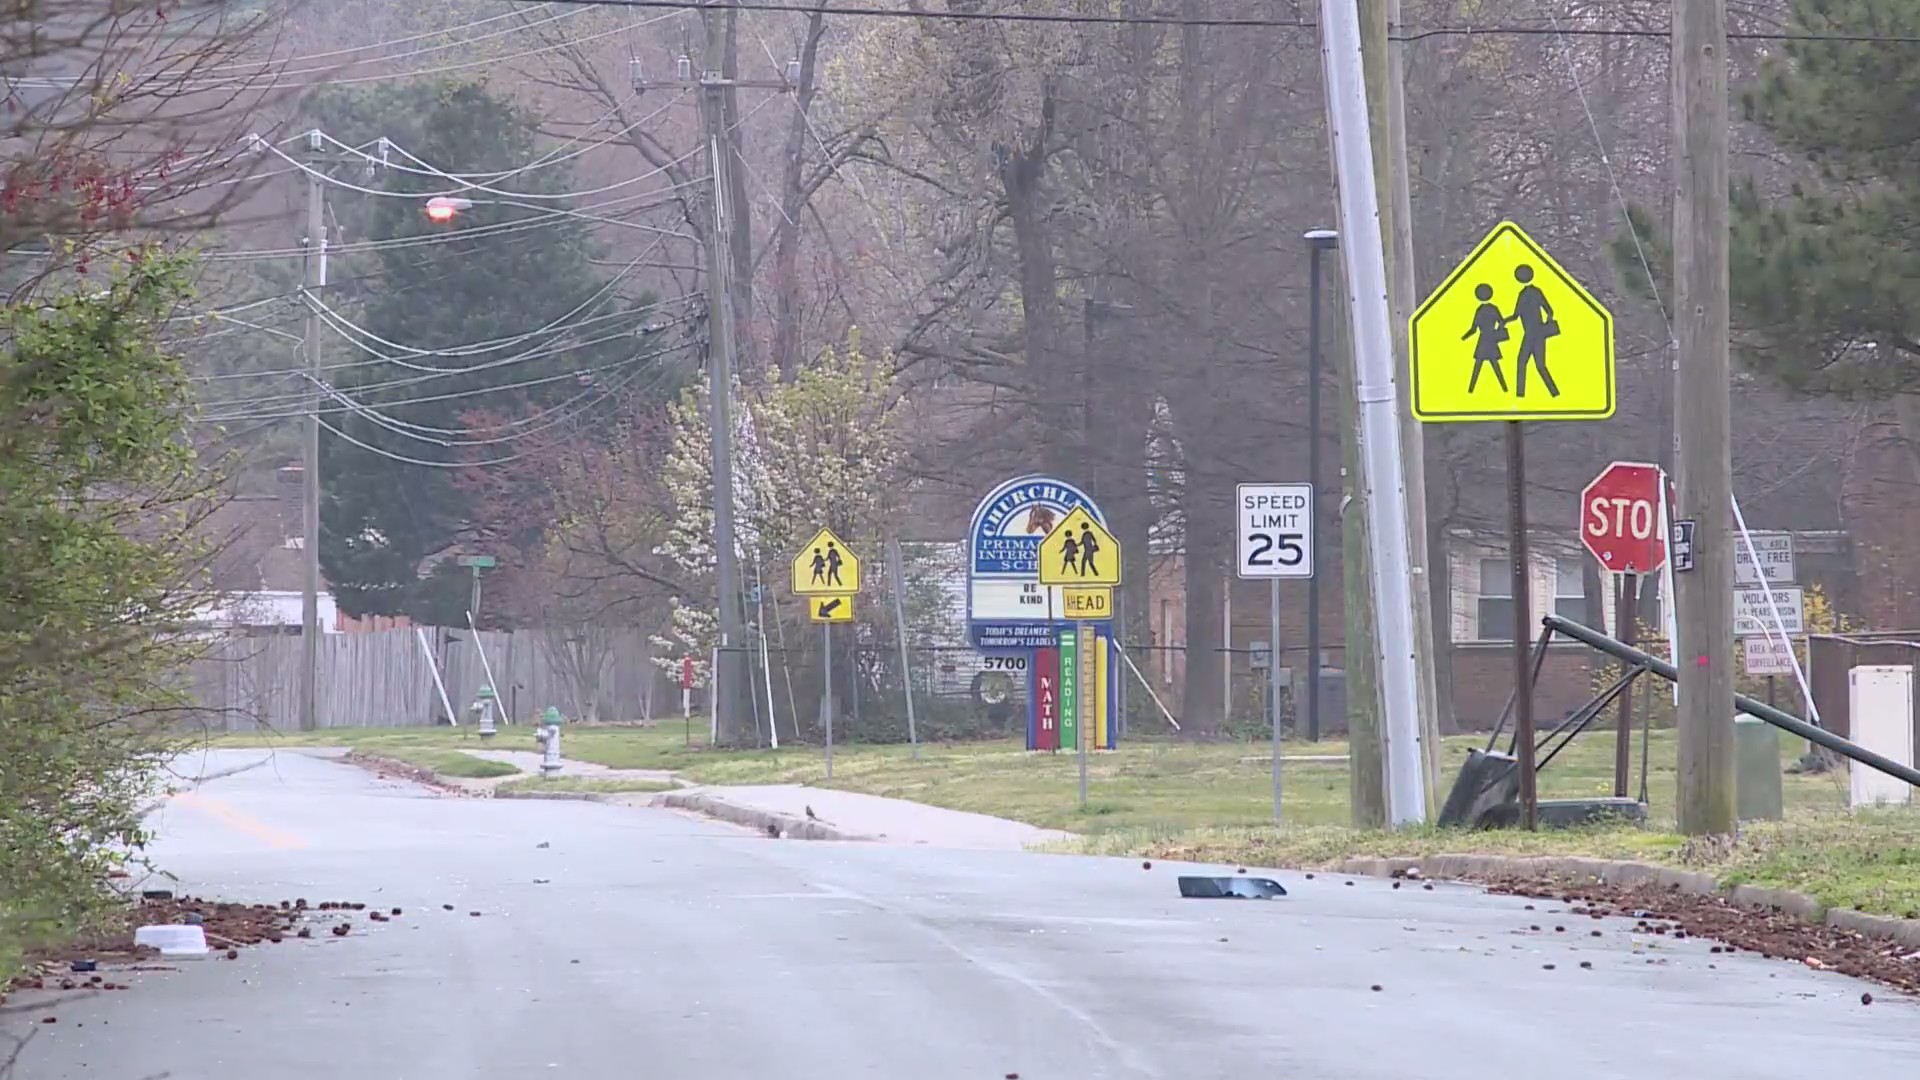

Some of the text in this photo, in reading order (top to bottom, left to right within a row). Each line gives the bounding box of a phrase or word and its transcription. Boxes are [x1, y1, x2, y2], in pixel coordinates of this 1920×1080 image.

[1244, 495, 1306, 510] SPEED
[1251, 514, 1299, 529] LIMIT
[982, 539, 1037, 550] PRIMA
[1247, 533, 1303, 567] 25
[1767, 551, 1790, 563] FREE
[1001, 560, 1038, 571] SCH
[1752, 566, 1776, 579] ZNE
[1023, 583, 1037, 593] BE
[1019, 595, 1043, 605] KIND
[1066, 595, 1105, 611] AHEAD
[1742, 591, 1790, 605] VIOLAORS
[1026, 637, 1057, 646] LEADES
[984, 656, 1026, 670] 5700
[1064, 656, 1073, 728] READING
[1040, 677, 1053, 731] MATH
